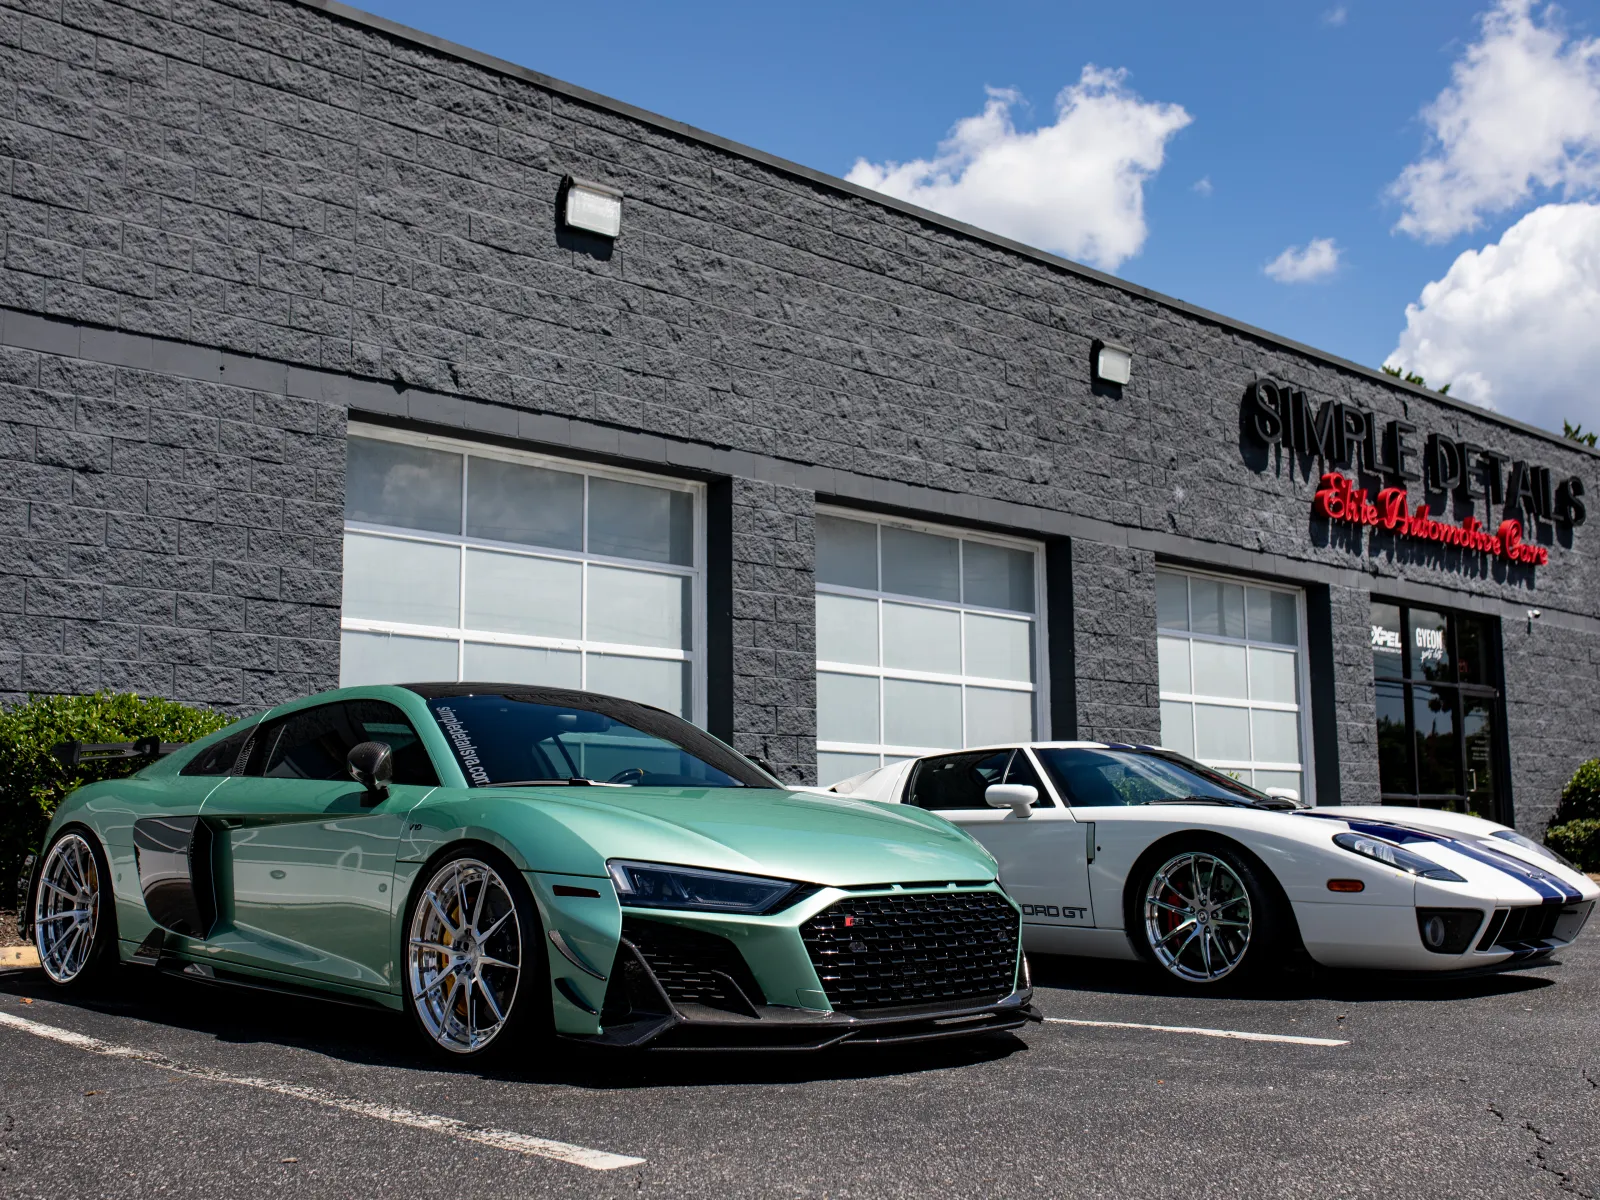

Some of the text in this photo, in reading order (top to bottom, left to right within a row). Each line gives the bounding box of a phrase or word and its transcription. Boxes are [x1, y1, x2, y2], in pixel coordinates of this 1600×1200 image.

[1251, 378, 1587, 527] SIMPLE DETAILS
[1315, 472, 1549, 566] Elite Automotive Care
[1371, 625, 1402, 648] XPEL
[1415, 627, 1443, 649] GYEON
[436, 706, 491, 787] simpledetailsva.com
[1019, 904, 1088, 919] ORD GT
